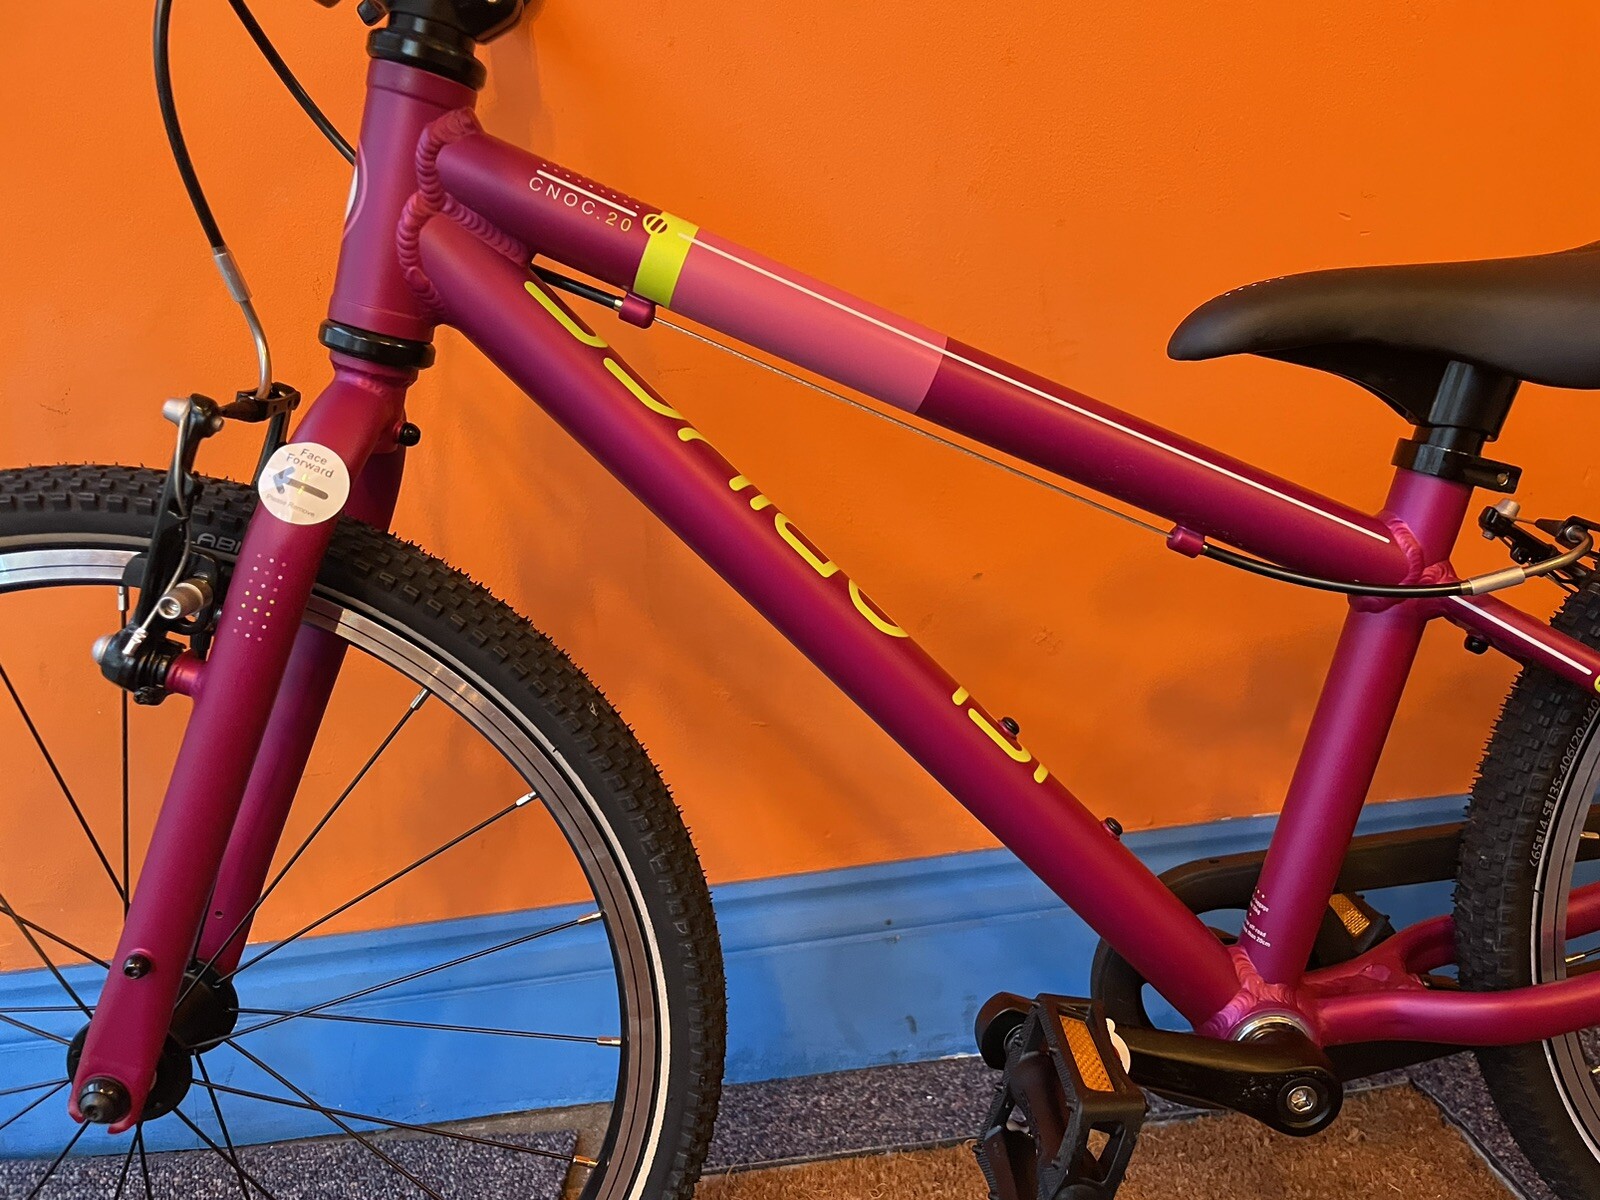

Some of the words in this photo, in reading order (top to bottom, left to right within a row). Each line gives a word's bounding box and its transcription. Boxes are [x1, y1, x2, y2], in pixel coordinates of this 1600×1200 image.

[529, 177, 632, 232] CNOC.20
[286, 453, 335, 478] Forward
[300, 448, 328, 465] Face
